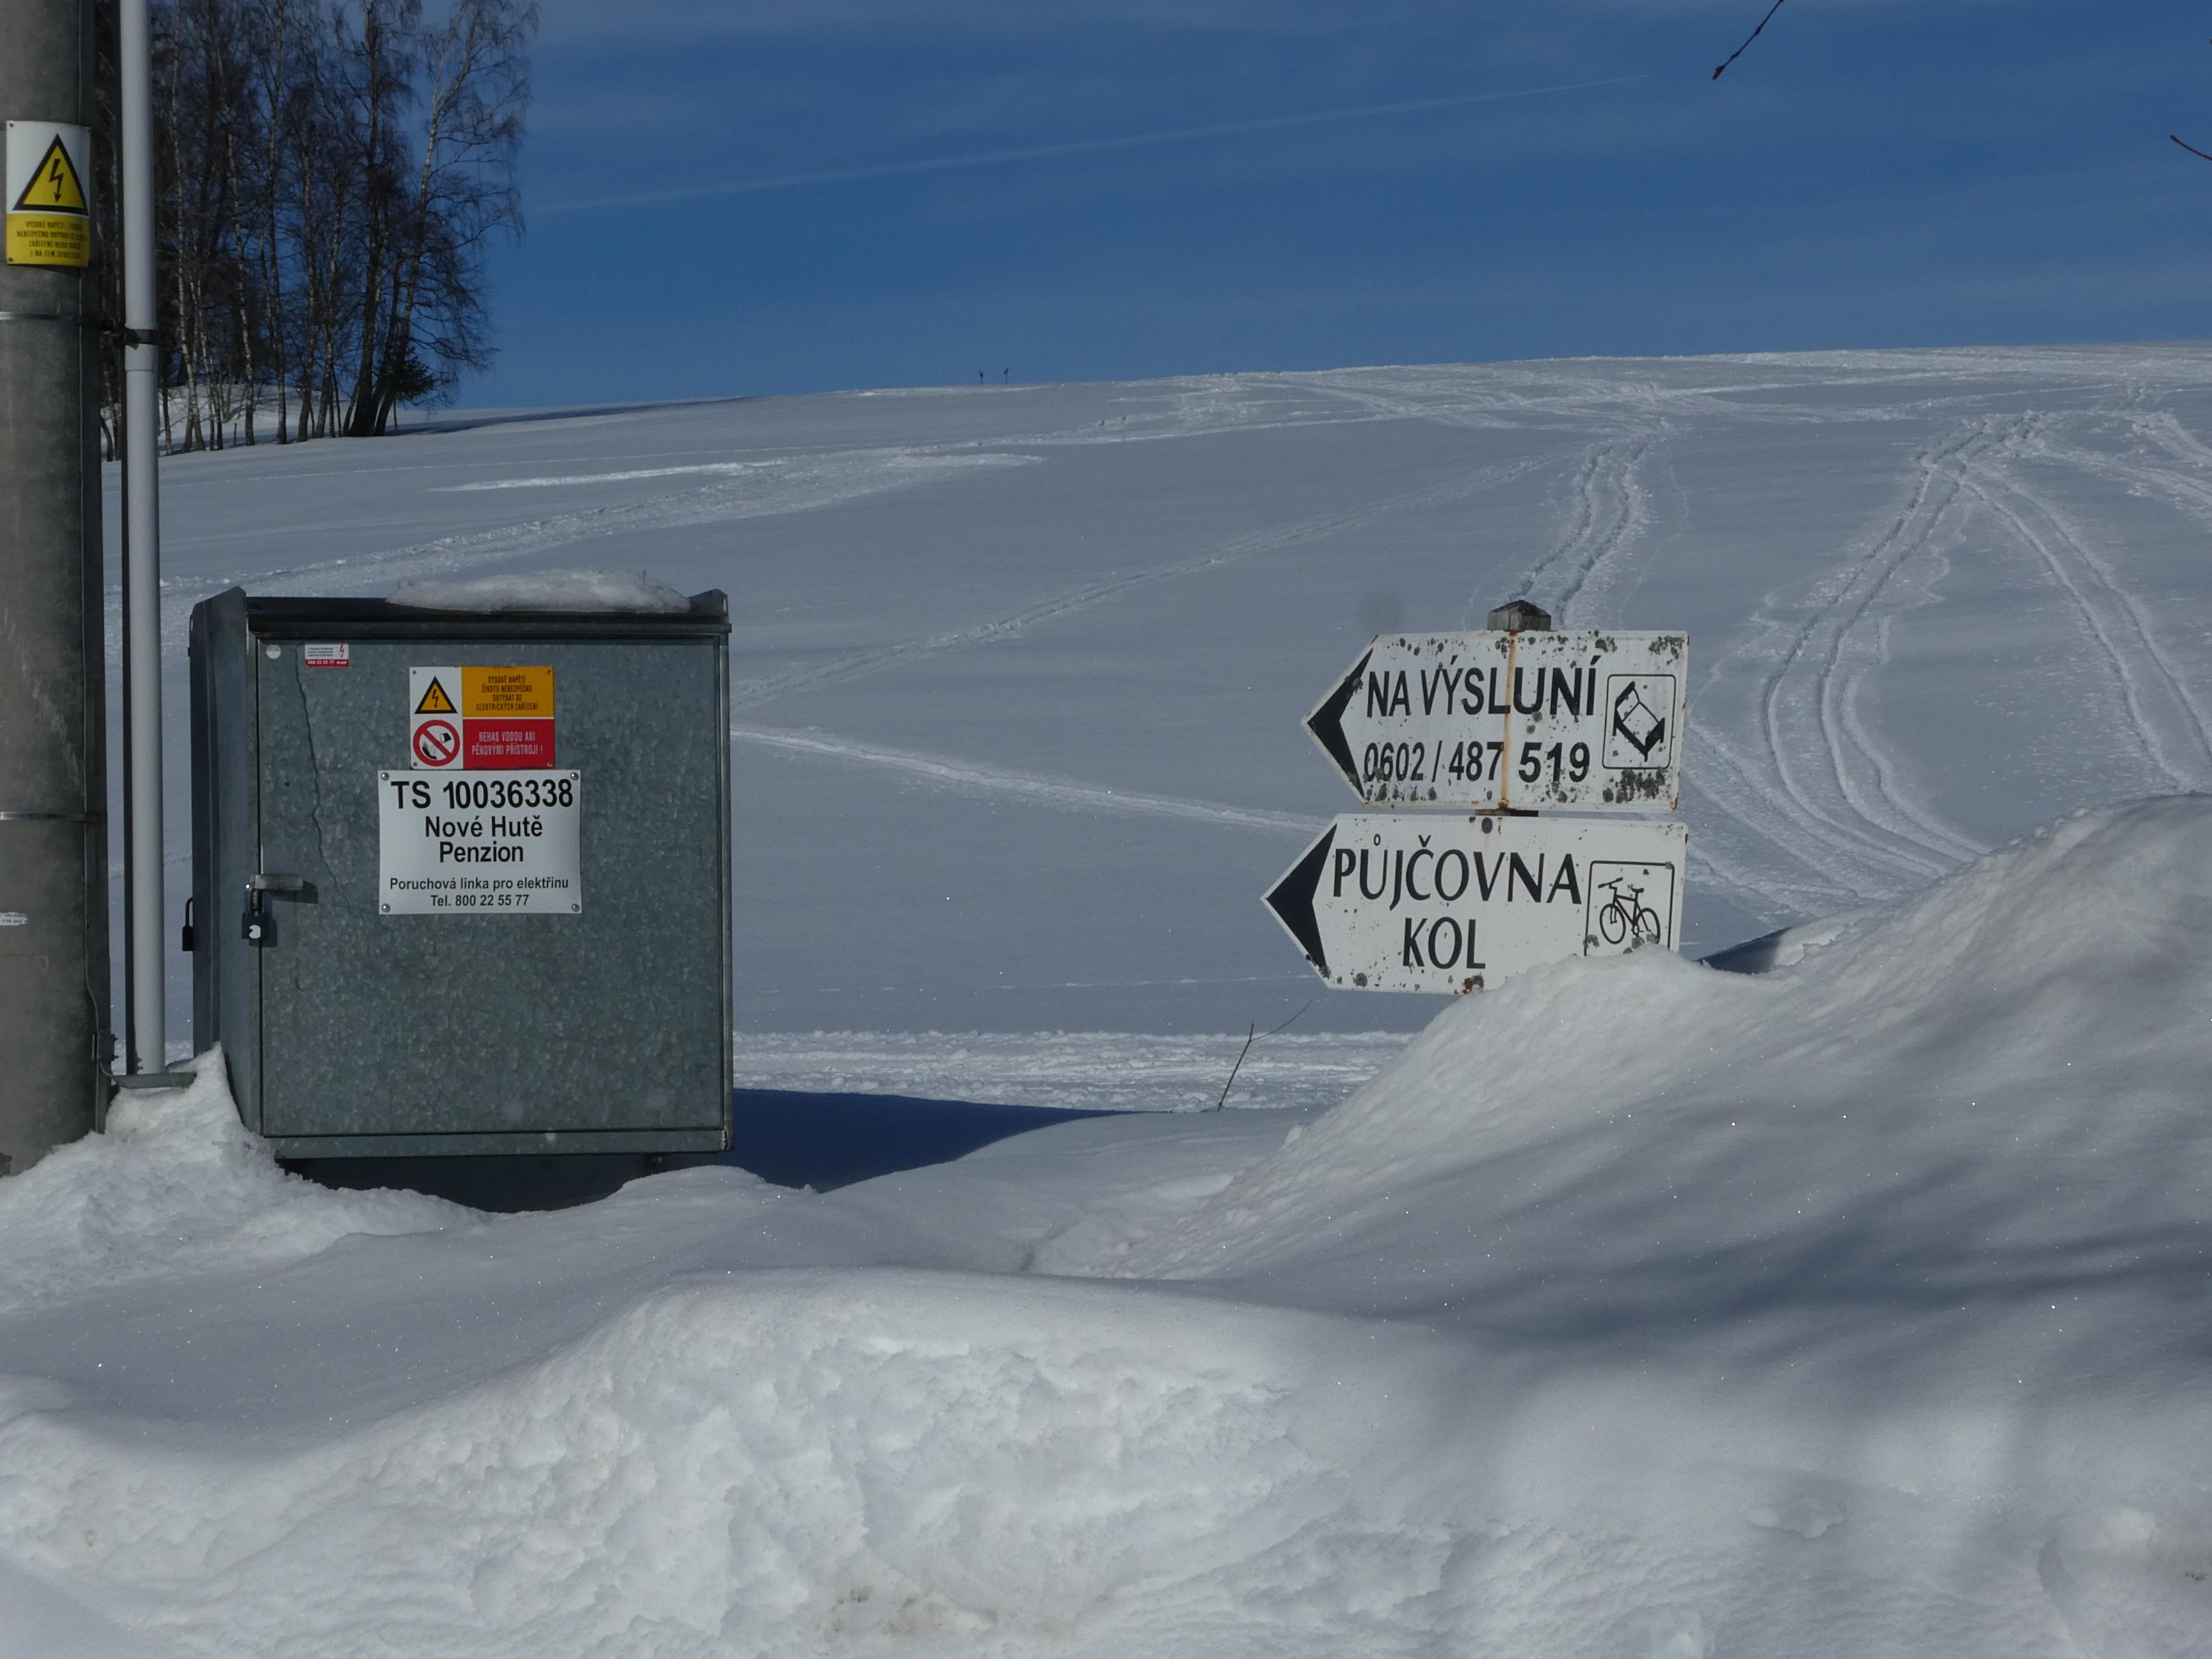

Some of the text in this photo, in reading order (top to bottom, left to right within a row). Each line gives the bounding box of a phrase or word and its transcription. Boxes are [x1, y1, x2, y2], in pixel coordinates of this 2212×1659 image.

[481, 683, 533, 693] ŽIVOTU NEBEZPEČNO
[488, 674, 526, 684] VYSOKÉ NAPĚTÍ
[1367, 655, 1601, 717] NA VÝSLUNÍ
[479, 732, 536, 742] NEHAS VODOU ANI
[472, 743, 504, 755] PĚNOVÝMI
[506, 742, 538, 755] PŘÍSTROJI
[1518, 742, 1590, 783] 519
[390, 779, 573, 809] TS 10036338
[425, 815, 543, 837] Nové Hutě
[440, 841, 524, 863] Penzion
[1333, 834, 1582, 911] PŮJČOVNA
[390, 877, 568, 891] Poruchová linka pro elektřinu
[431, 894, 529, 906] Tel. 800 22 55 77
[1402, 917, 1486, 970] KOL
